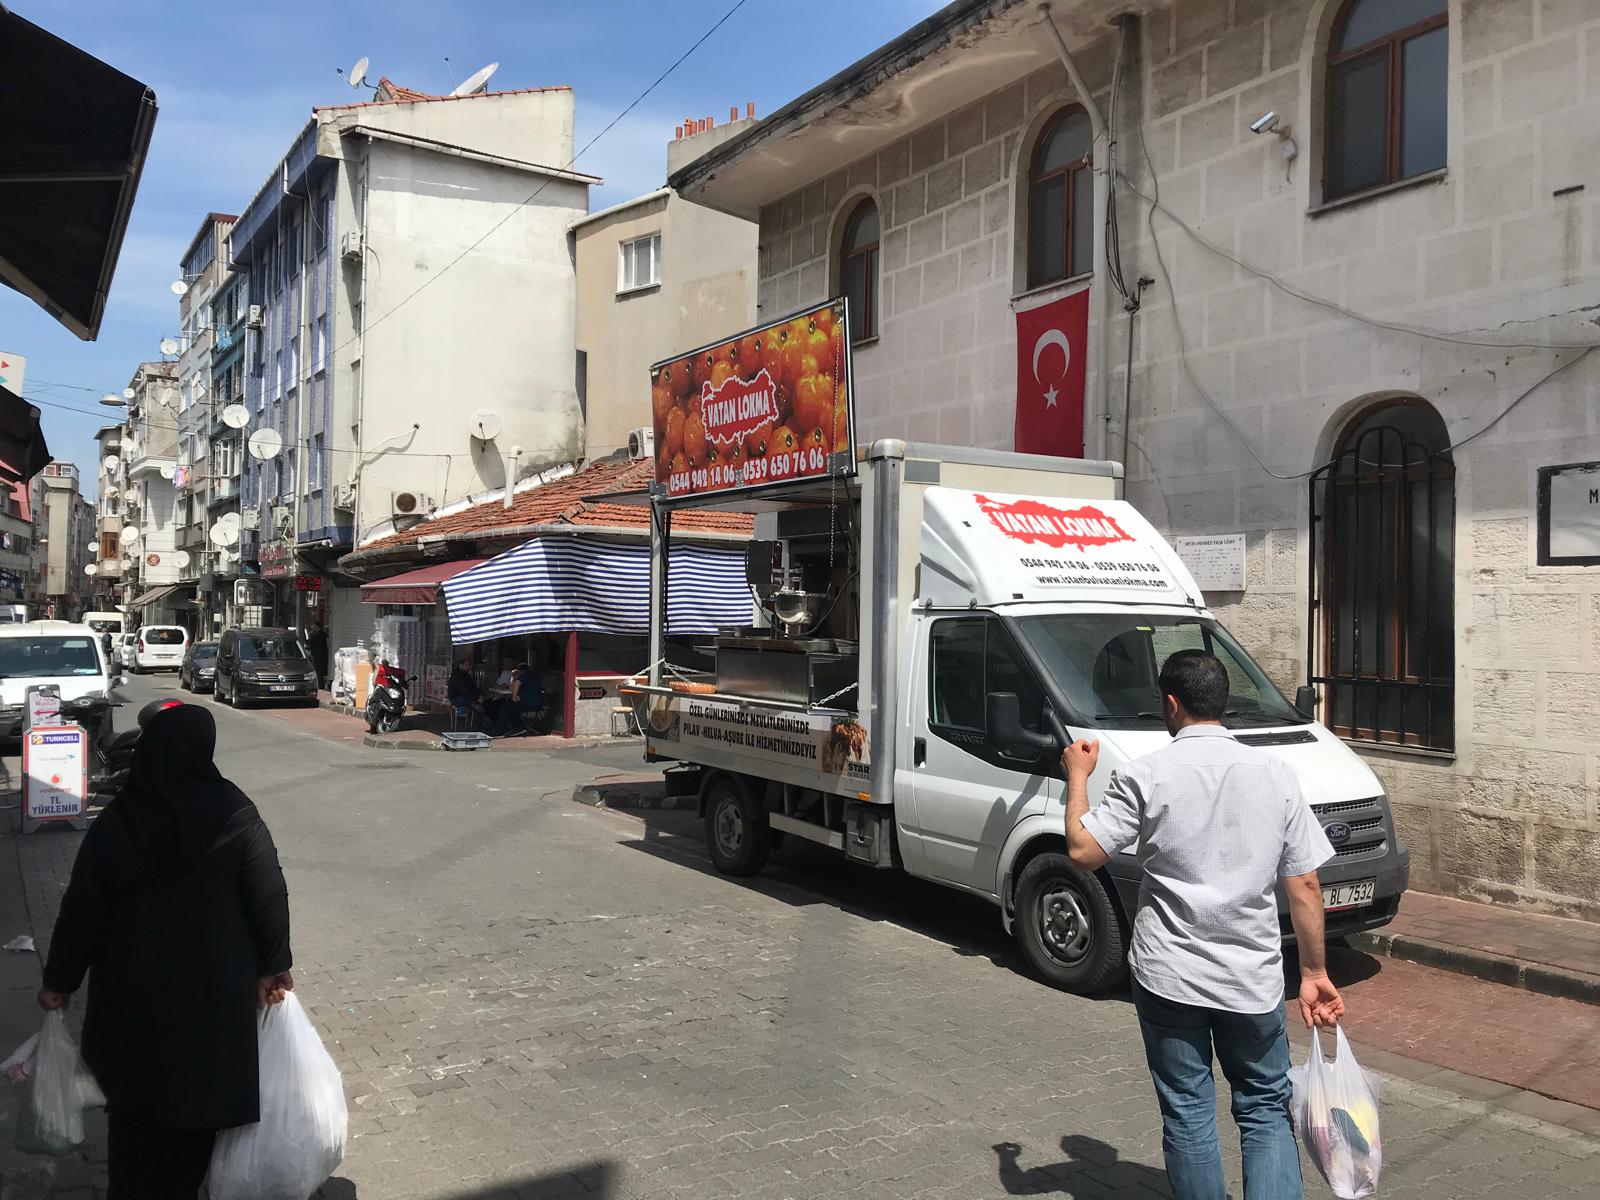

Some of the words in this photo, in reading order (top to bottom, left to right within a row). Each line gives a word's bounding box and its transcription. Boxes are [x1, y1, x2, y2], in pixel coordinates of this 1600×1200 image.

[707, 400, 736, 427] VATAN
[738, 390, 770, 420] LOKMA
[670, 472, 690, 492] 0544
[692, 469, 708, 489] 942
[710, 466, 721, 486] 14
[723, 464, 735, 484] 06
[743, 458, 767, 480] 0539
[771, 453, 790, 476] 650
[793, 450, 807, 472] 76
[809, 447, 824, 470] 06
[992, 511, 1061, 536] VATAN
[1053, 516, 1123, 539] LOKMA
[1020, 558, 1046, 569] 0544
[1045, 559, 1064, 570] 942
[1064, 561, 1078, 571] 14
[1078, 561, 1090, 571] 06
[1094, 562, 1119, 572] 0539
[1118, 563, 1135, 573] 650
[1134, 563, 1148, 573] 76
[1147, 564, 1160, 573] 06
[1037, 575, 1168, 588] www.istanbulvatanlokma.com
[689, 702, 703, 718] ÖZEL
[705, 704, 749, 725] GÜNLERİNİZDE
[750, 712, 810, 735] MEVLİTLERİNİZDE
[45, 734, 79, 743] TURKCELL
[684, 720, 700, 737] PİLAV
[745, 729, 755, 747] İLE
[756, 732, 817, 759] HİZMETİNİZDEYİZ
[32, 803, 78, 814] YÜKLENİR
[1330, 825, 1347, 838] Ford
[1330, 887, 1343, 906] BL
[1348, 883, 1373, 904] 7532
